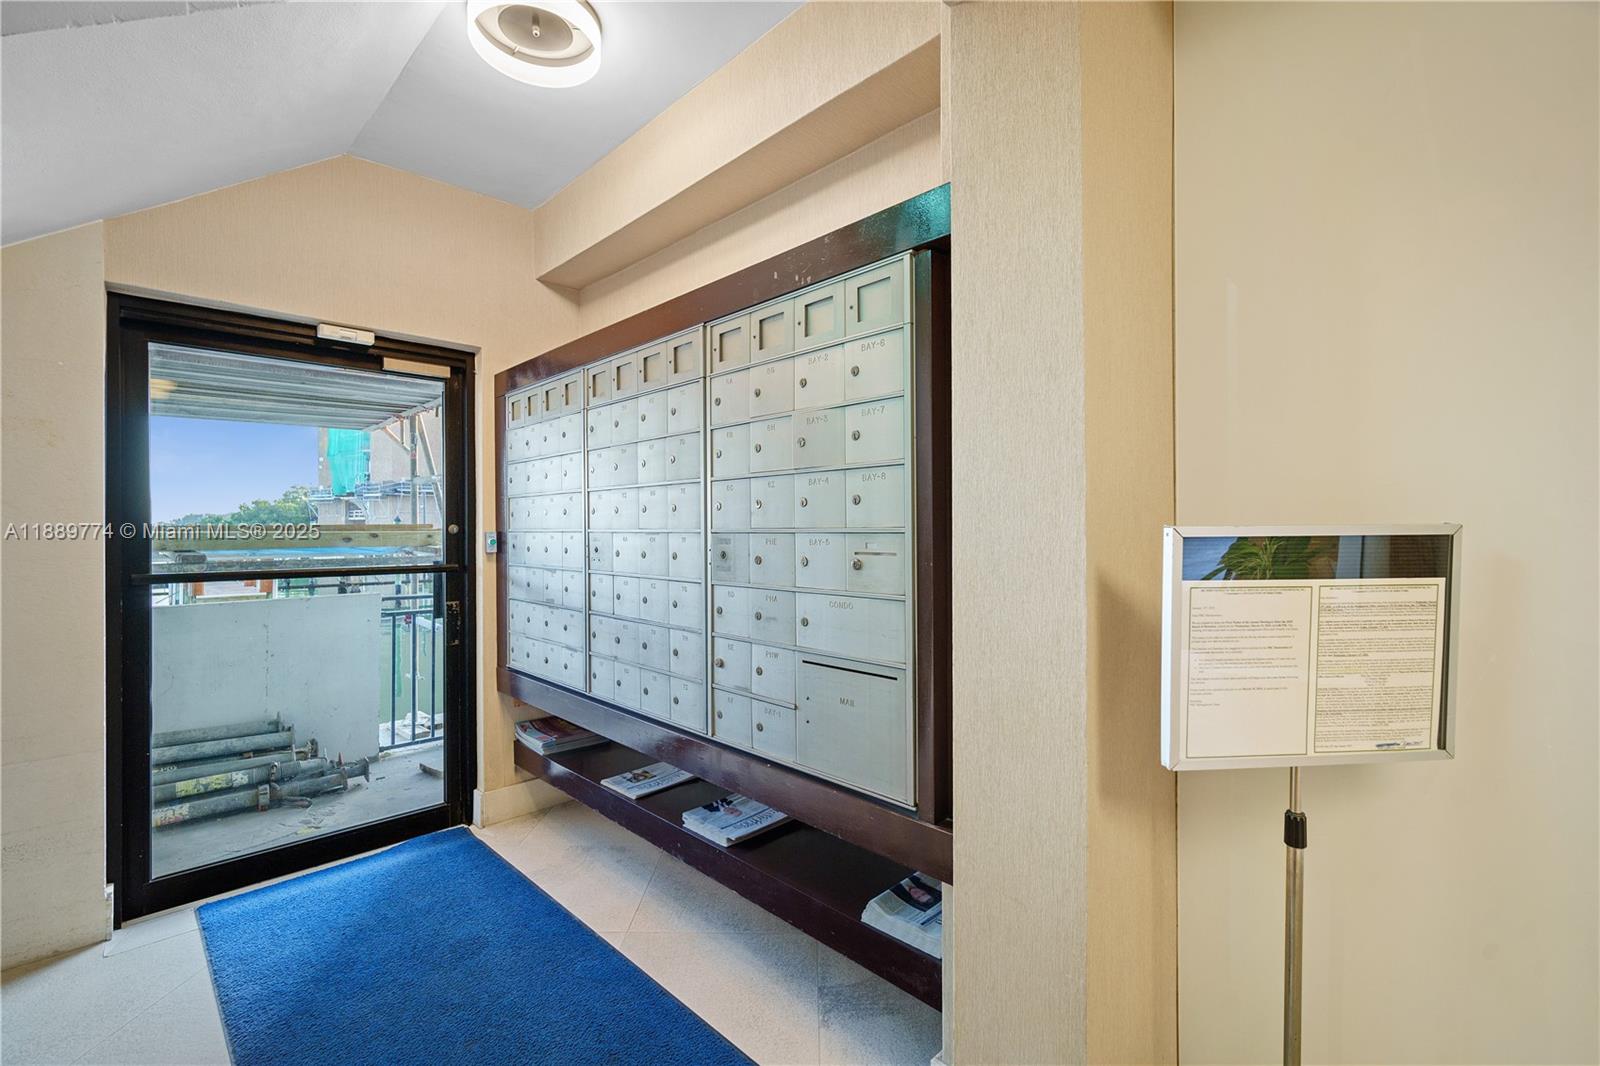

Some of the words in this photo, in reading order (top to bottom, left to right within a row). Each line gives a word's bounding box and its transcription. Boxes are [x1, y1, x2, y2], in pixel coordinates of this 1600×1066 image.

[861, 339, 886, 352] BAY-6
[807, 353, 829, 366] BAY-2
[861, 406, 886, 417] BAY-7
[806, 415, 829, 425] BAY-3
[808, 478, 830, 486] BAY-4
[862, 473, 887, 482] BAY-8
[808, 538, 831, 546] BAY-5
[829, 600, 854, 610] CONDO
